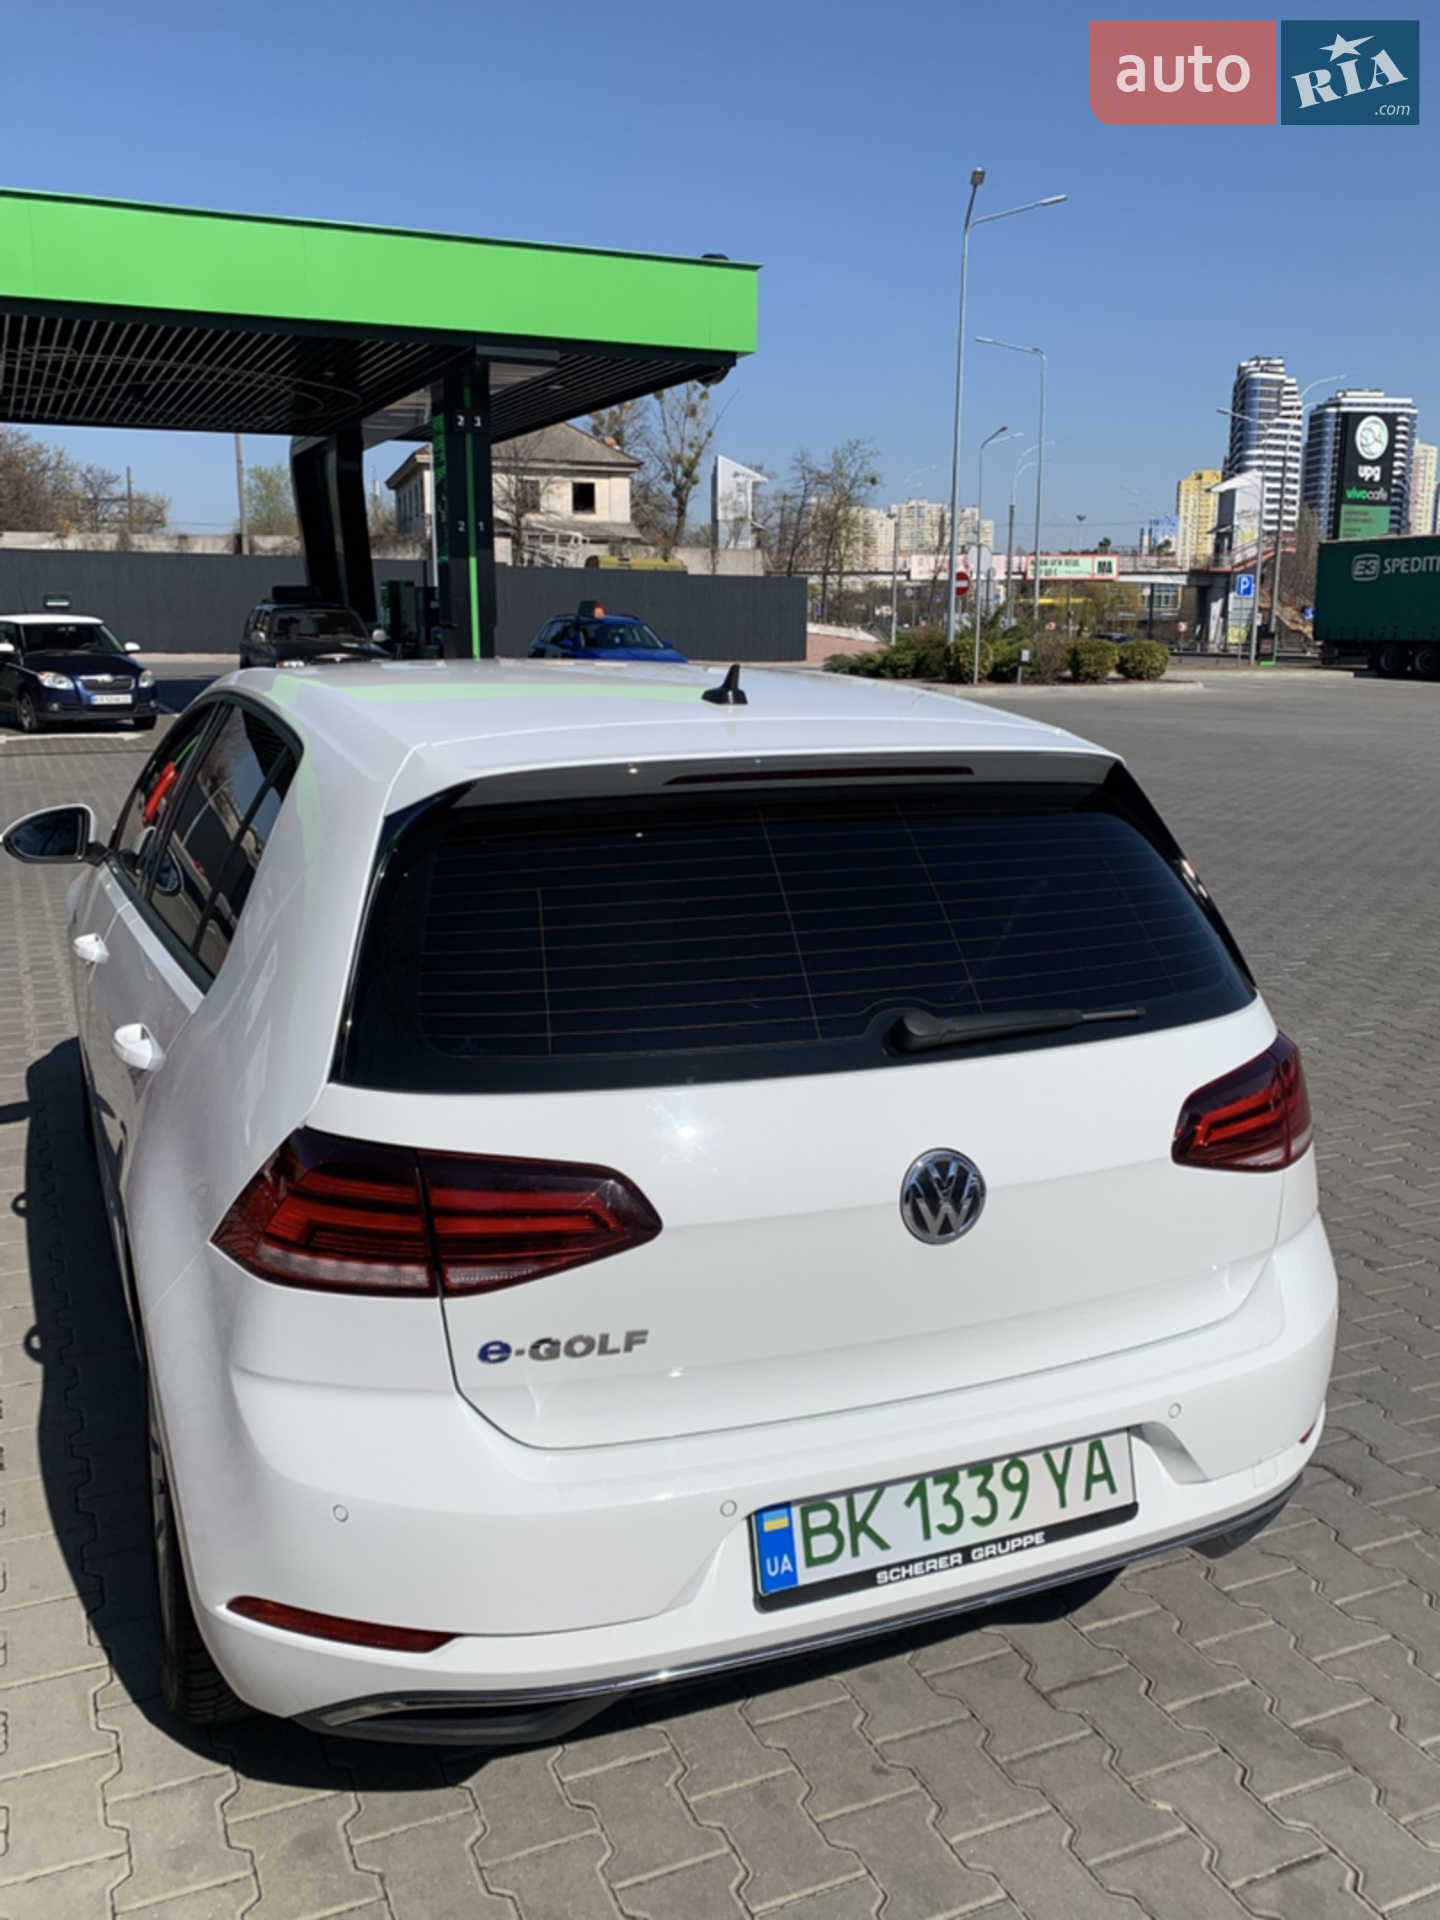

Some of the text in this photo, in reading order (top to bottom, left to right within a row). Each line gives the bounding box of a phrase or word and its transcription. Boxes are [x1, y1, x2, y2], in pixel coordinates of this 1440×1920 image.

[1358, 465, 1382, 482] upg
[1240, 576, 1251, 595] P
[477, 1329, 649, 1365] e-GOLF
[799, 1438, 1118, 1569] BK 1339 YA
[766, 1553, 794, 1578] UA
[875, 1531, 1046, 1586] SCHERER GRUPPE
